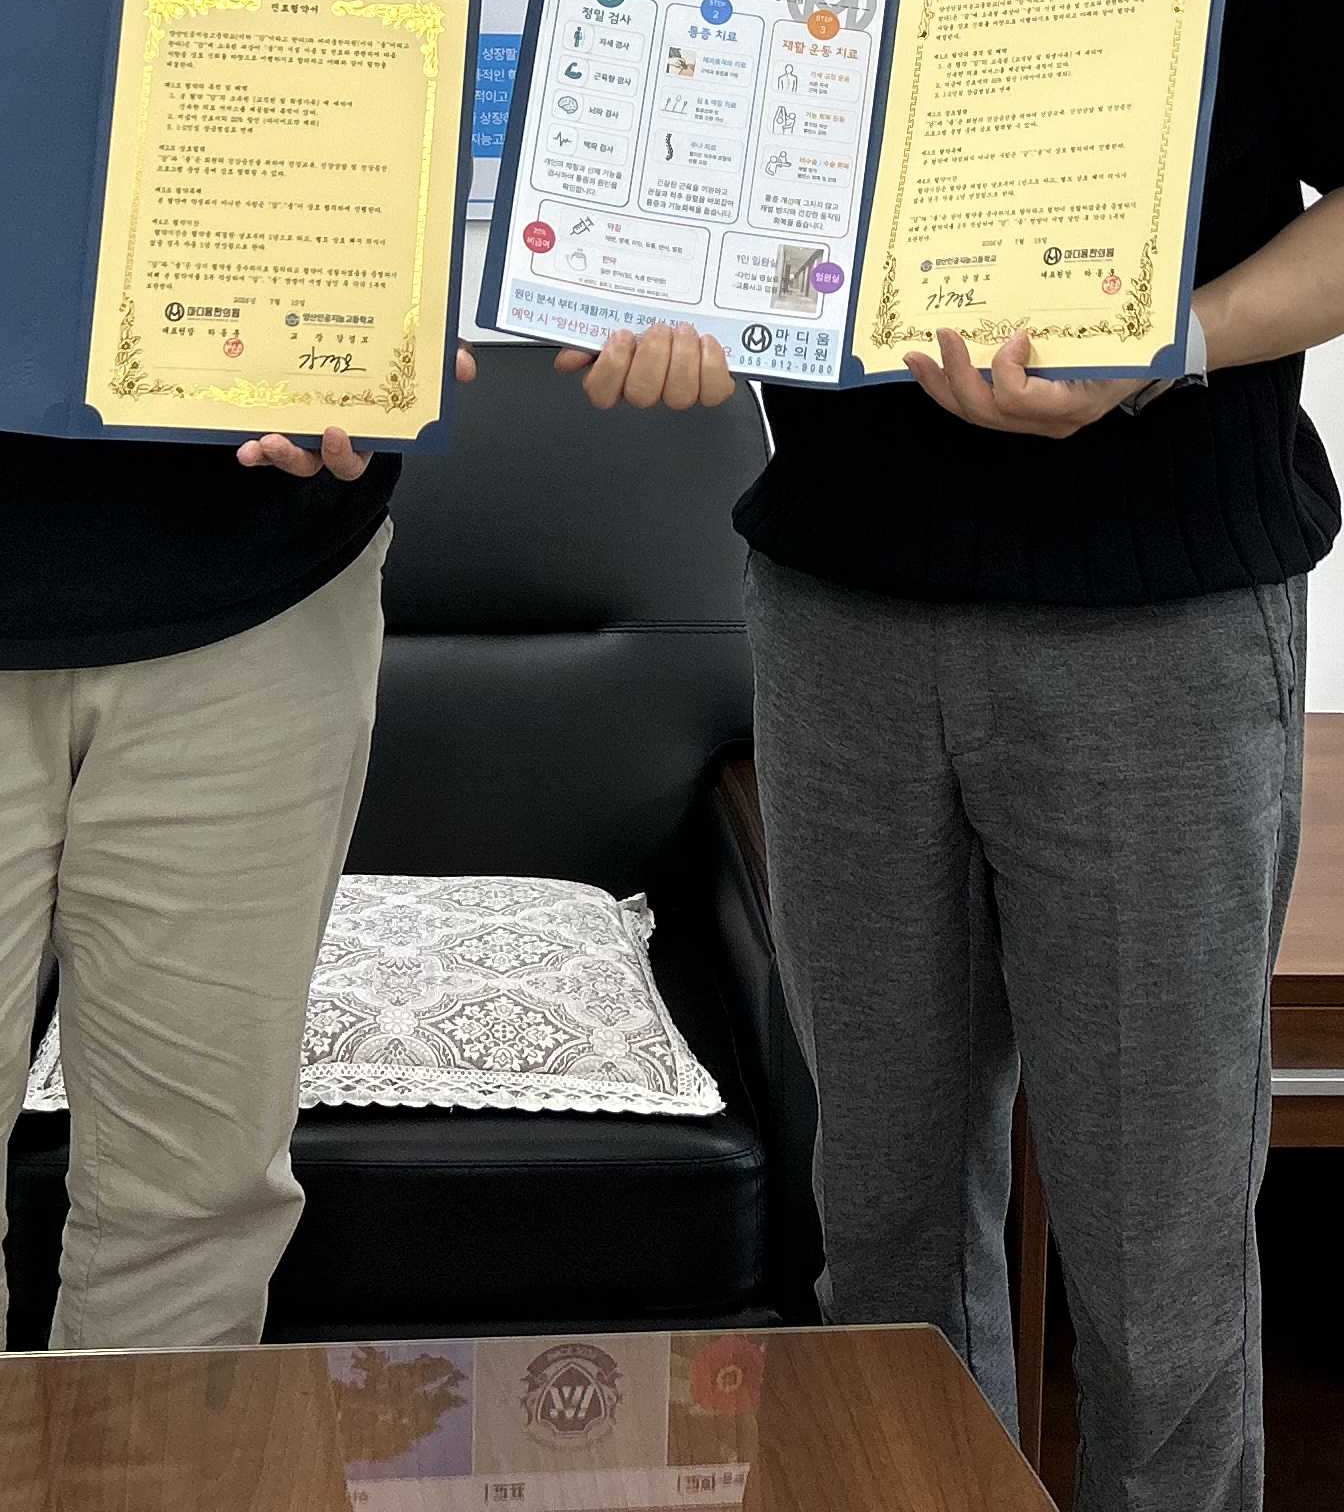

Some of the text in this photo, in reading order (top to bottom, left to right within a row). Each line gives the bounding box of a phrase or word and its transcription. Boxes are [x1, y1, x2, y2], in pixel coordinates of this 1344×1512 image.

[582, 7, 631, 25] 정밀 검사
[713, 11, 719, 19] 2
[820, 26, 826, 34] 3
